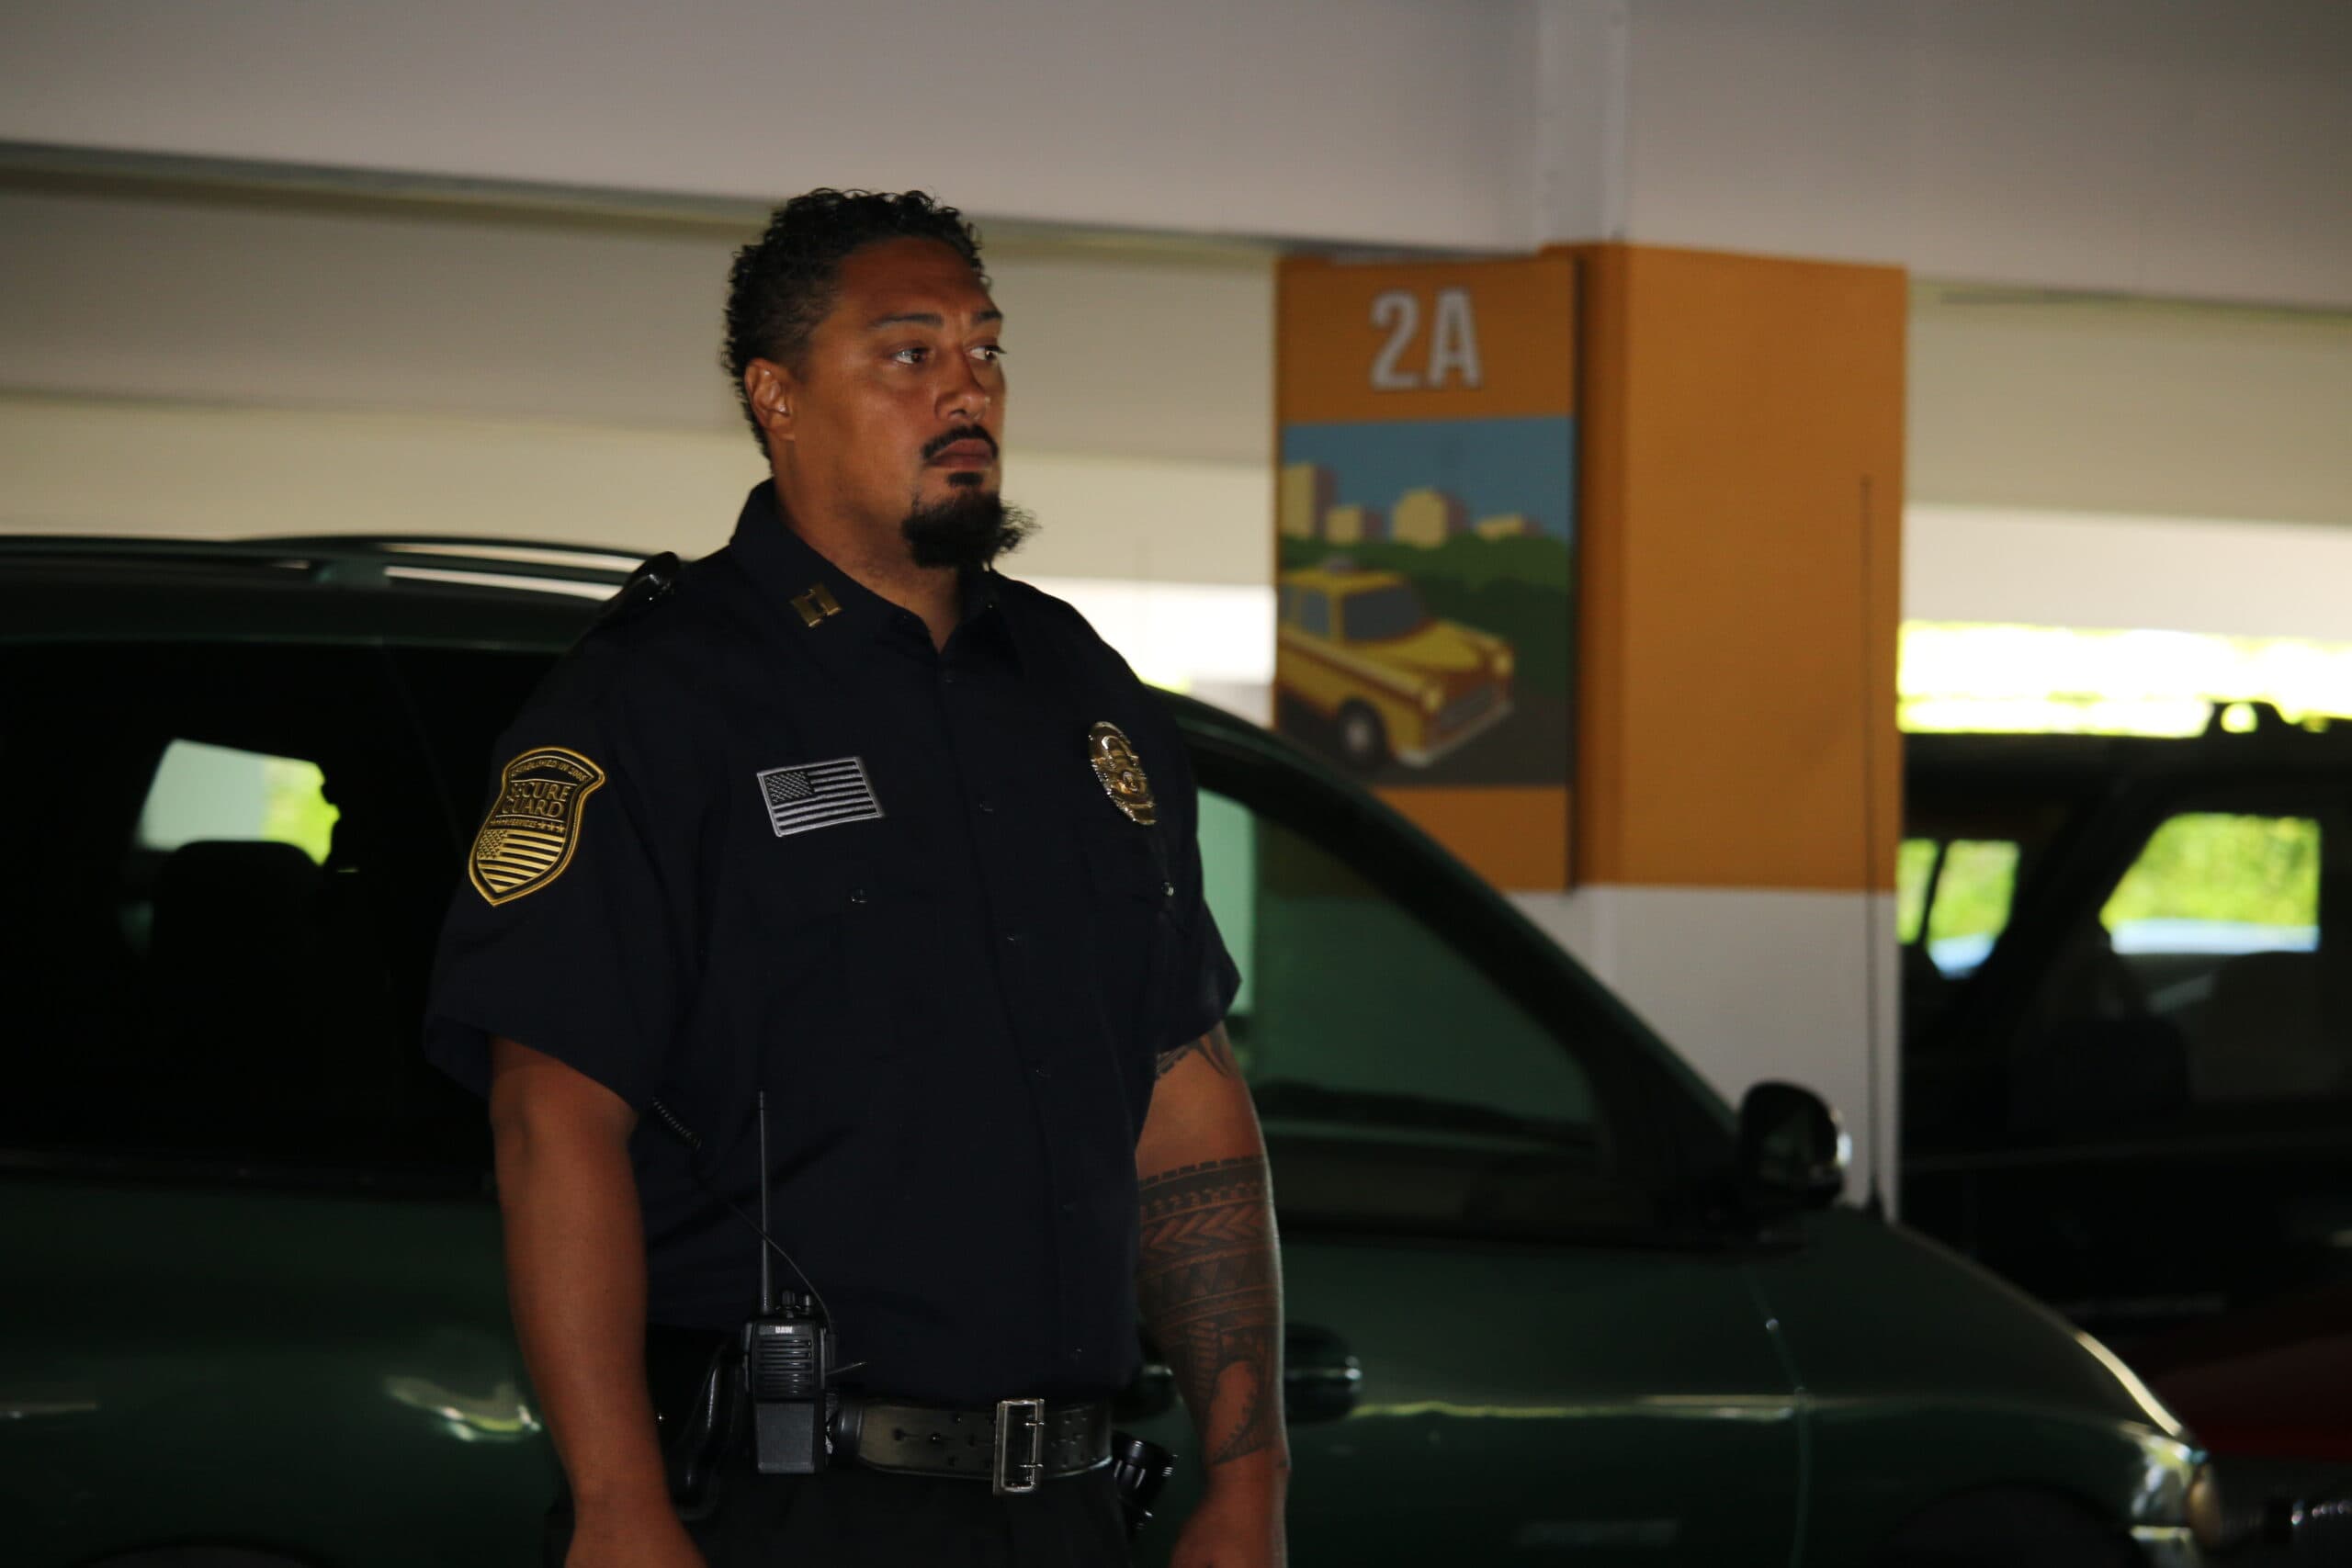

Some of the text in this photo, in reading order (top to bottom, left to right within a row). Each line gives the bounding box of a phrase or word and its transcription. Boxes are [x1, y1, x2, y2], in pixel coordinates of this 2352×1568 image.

[1369, 286, 1484, 391] 2A
[510, 782, 571, 802] SECURE
[502, 796, 565, 818] GUARD
